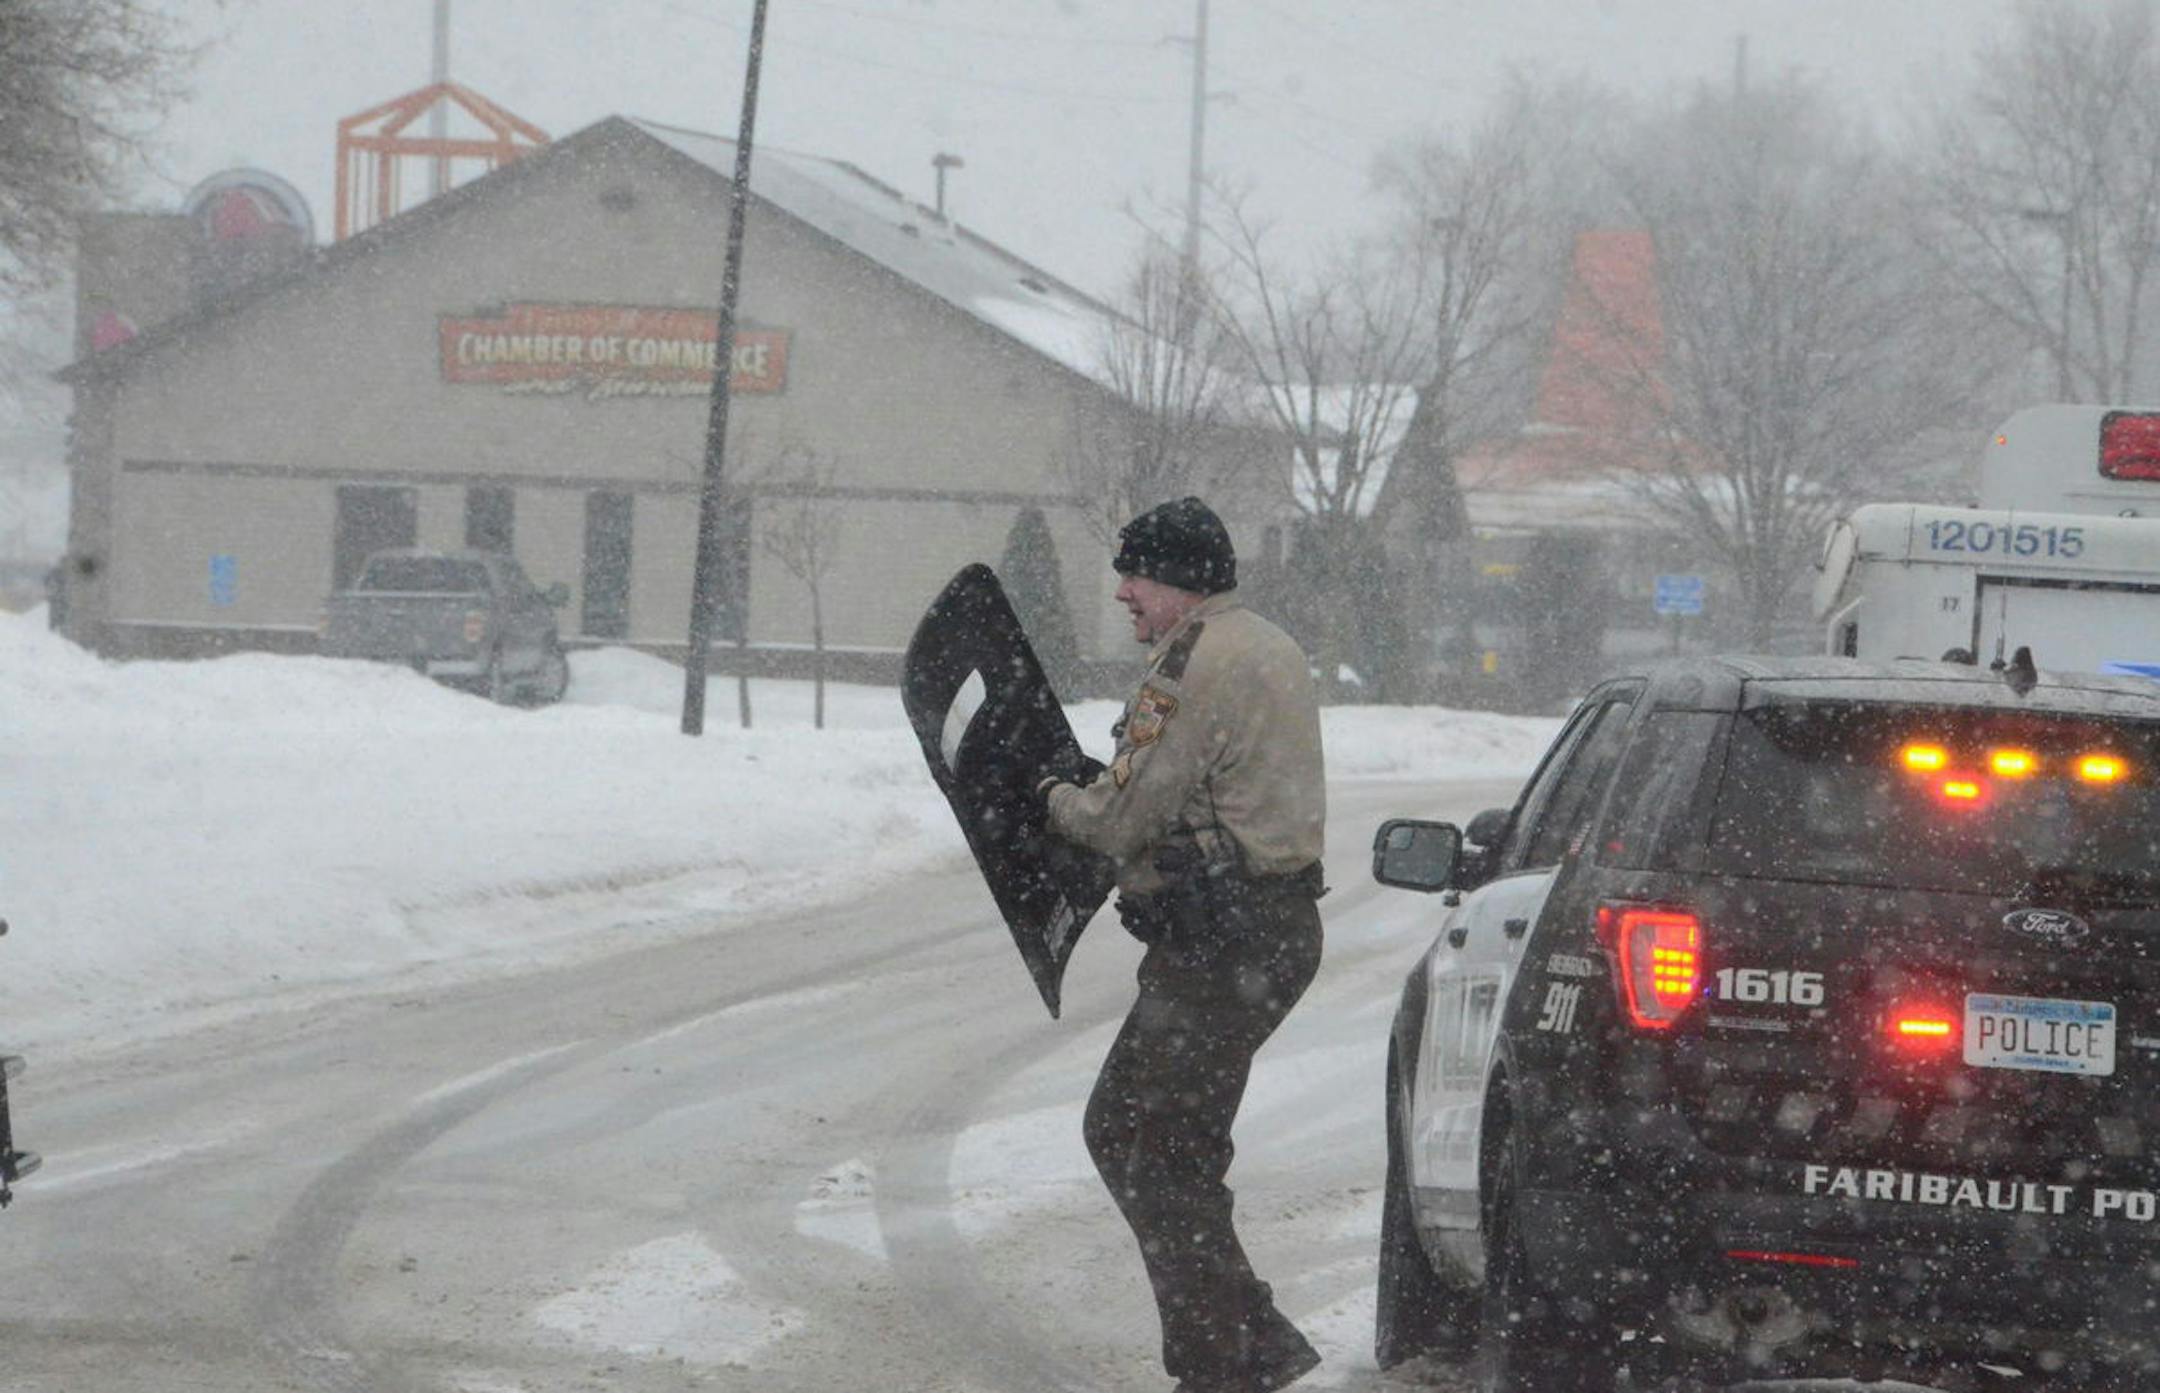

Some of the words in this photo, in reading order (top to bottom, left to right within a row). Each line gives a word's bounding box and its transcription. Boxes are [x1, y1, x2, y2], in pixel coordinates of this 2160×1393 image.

[457, 333, 583, 364] CHAMBER
[589, 335, 624, 363] OF
[1925, 519, 2085, 558] 1201515
[2022, 913, 2071, 934] Ford
[1715, 967, 1825, 1006] 1616
[1536, 981, 1584, 1034] 911
[1978, 1015, 2104, 1060] POLICE
[1803, 1164, 2073, 1215] FARIBAULT
